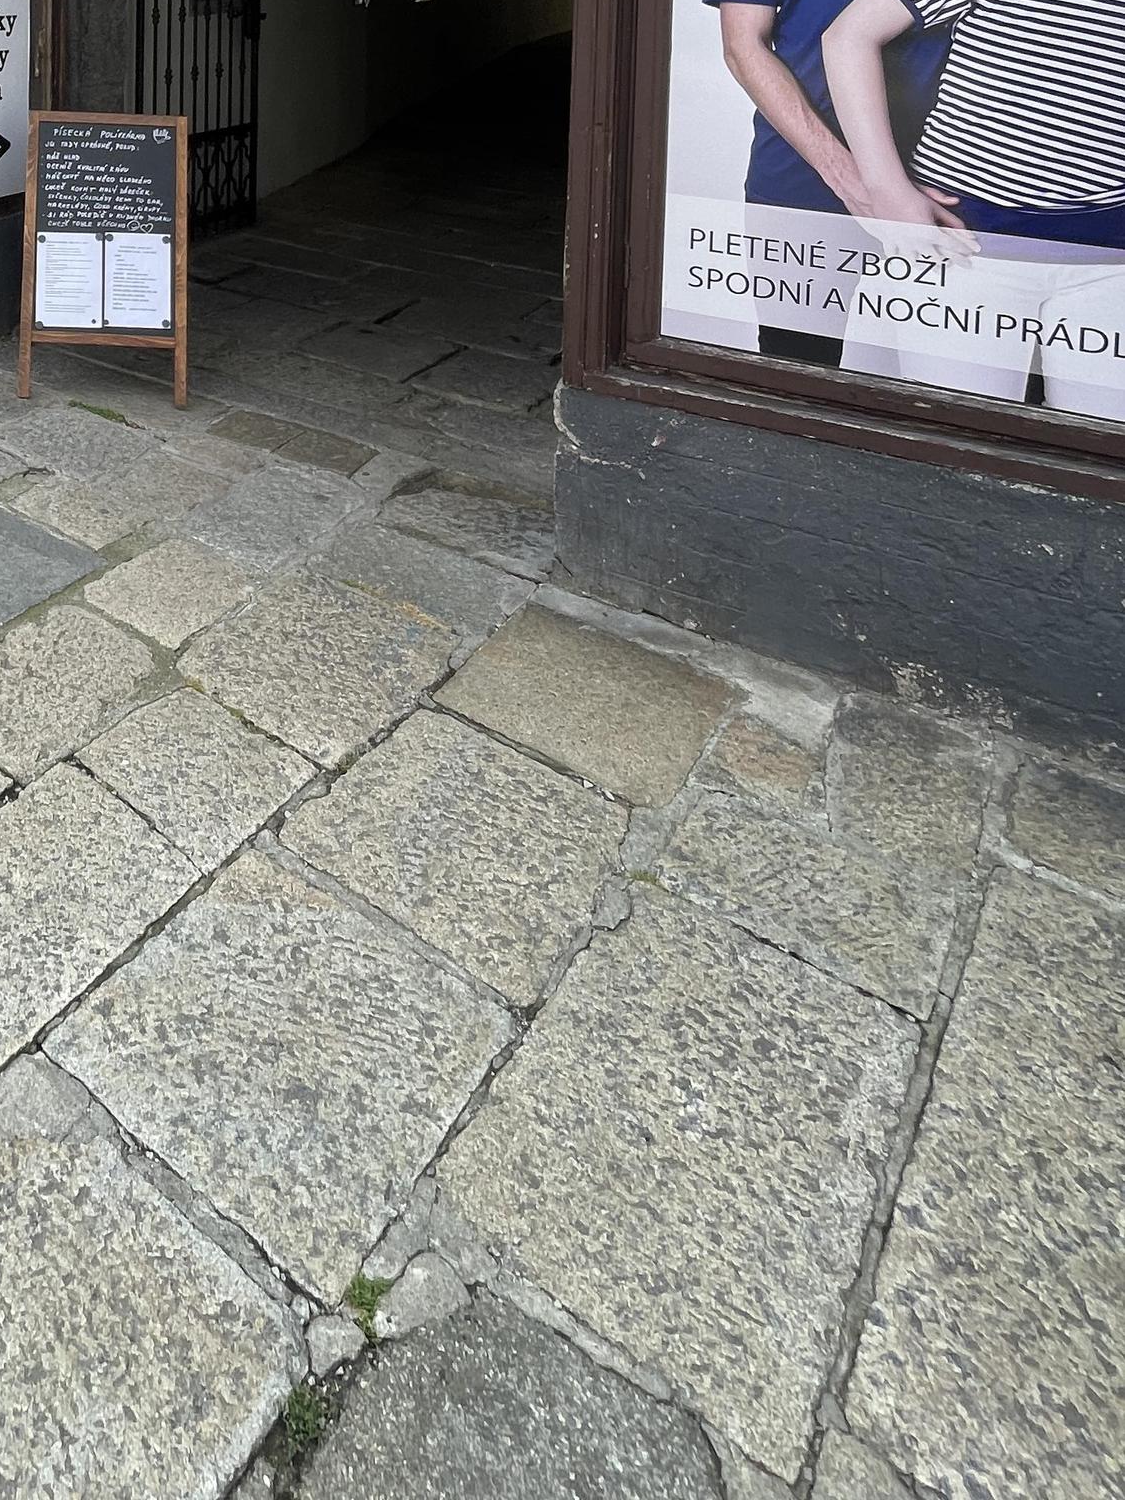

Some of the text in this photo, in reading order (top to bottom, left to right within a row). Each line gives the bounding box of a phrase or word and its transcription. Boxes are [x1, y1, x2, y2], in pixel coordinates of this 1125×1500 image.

[53, 126, 93, 137] PÍSECKÁ
[690, 228, 950, 287] PLETENÉ ZBOŽÍ
[688, 265, 1125, 359] SPODNÍ A NOČNÍ PRÁDL
